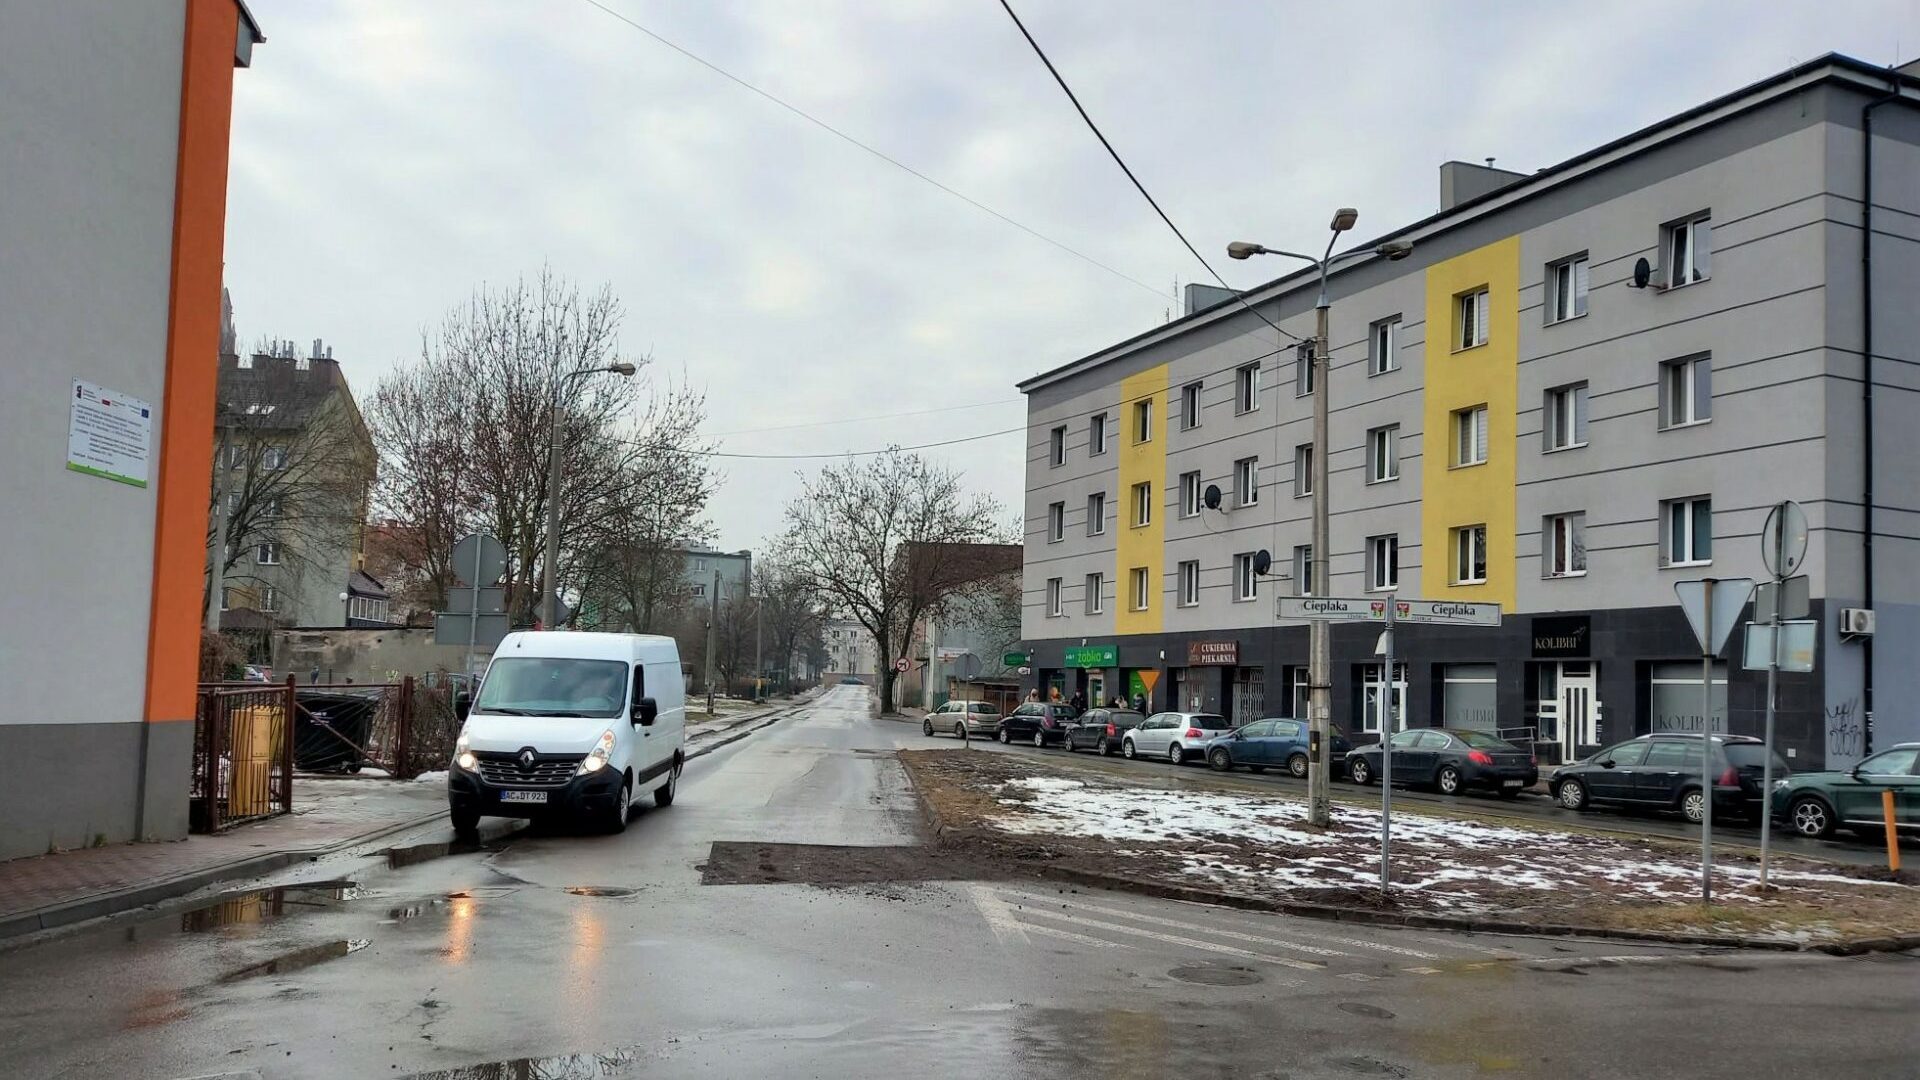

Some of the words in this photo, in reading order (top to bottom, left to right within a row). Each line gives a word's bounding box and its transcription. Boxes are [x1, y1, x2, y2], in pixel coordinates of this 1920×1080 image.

[1303, 600, 1348, 613] Cieplaka
[1431, 604, 1476, 618] Cieplaka
[1201, 643, 1236, 652] CUKIERNIA
[1201, 654, 1236, 663] PIEKARNIA
